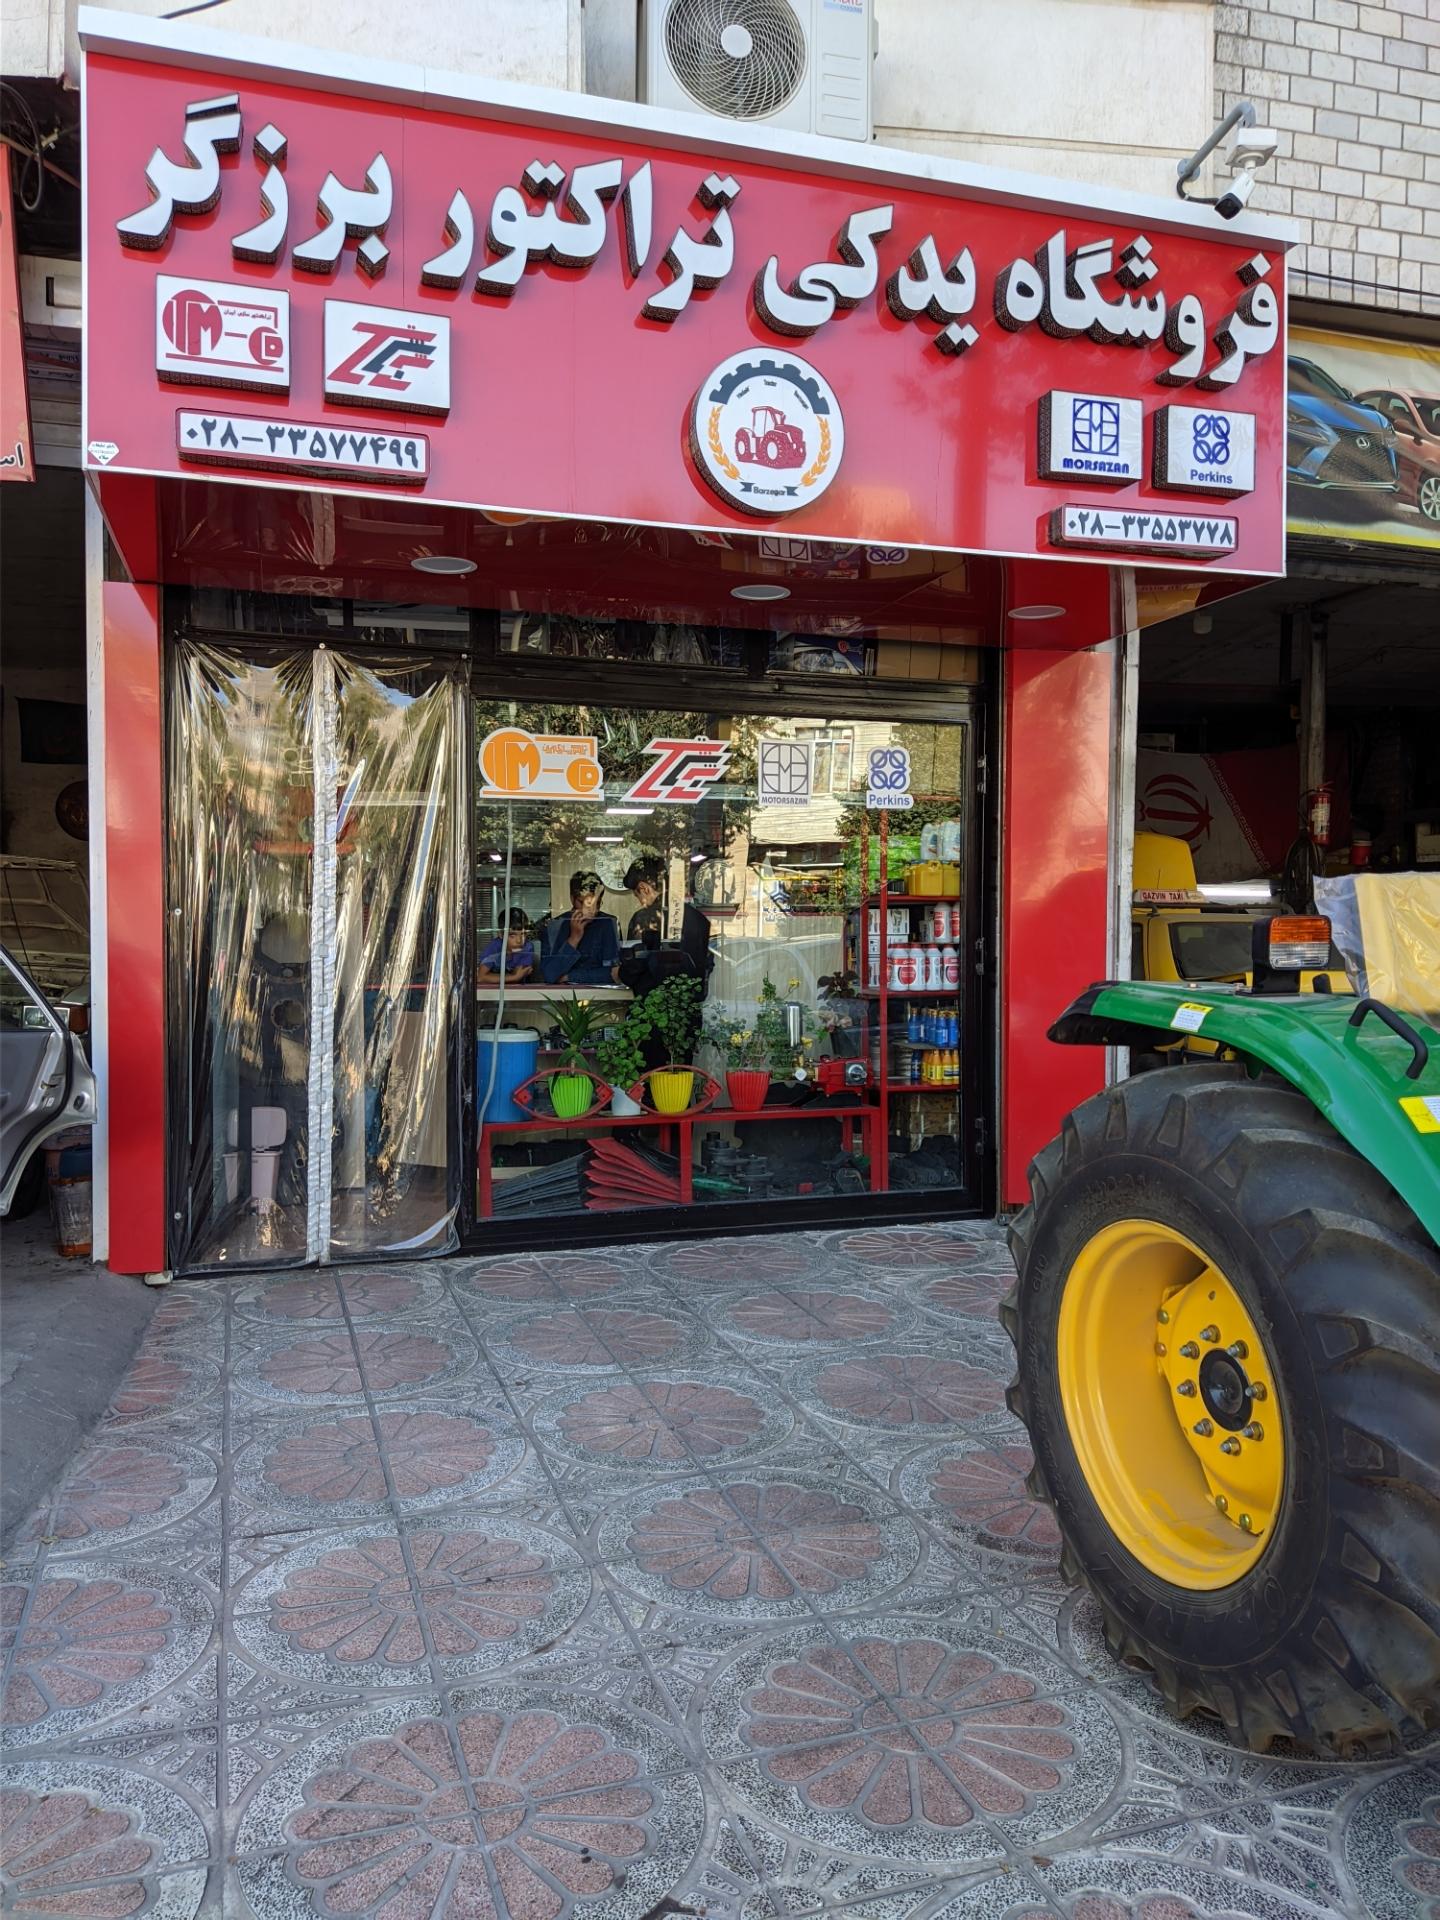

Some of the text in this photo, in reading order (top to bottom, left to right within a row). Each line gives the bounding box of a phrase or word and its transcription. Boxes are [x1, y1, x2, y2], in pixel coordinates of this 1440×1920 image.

[116, 93, 1279, 387] فروشگاه یدکی تراکتور برزگر
[1190, 469, 1233, 485] Perkins
[869, 794, 910, 806] Perkins
[1168, 892, 1184, 901] TAXI
